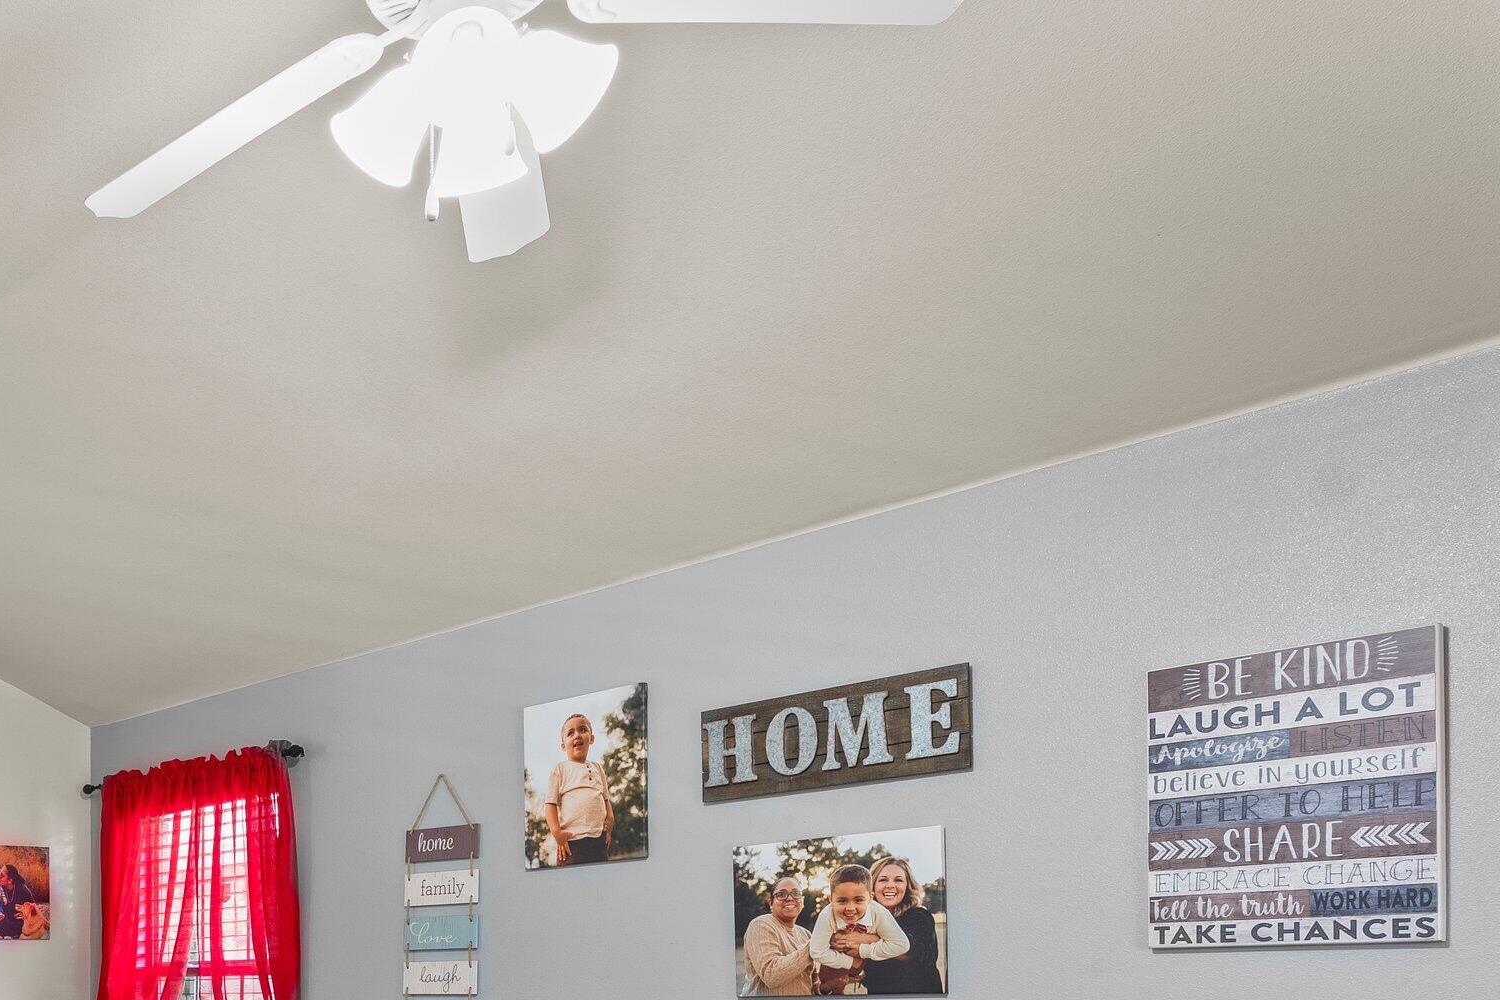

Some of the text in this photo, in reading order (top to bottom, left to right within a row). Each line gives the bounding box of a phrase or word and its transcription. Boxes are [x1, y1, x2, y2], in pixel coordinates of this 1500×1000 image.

[1207, 638, 1370, 700] BE KIND
[1149, 681, 1422, 741] LAUGH A LOT
[702, 677, 961, 788] HOME
[1300, 714, 1427, 752] LISTEN
[1152, 734, 1286, 766] Apologize
[1153, 768, 1246, 795] believe
[1154, 777, 1436, 828] OFFER TO HELP
[417, 832, 455, 853] home
[1222, 820, 1344, 864] SHARE
[420, 877, 465, 900] family
[1154, 857, 1436, 894] EMBRACE CHANGE
[1150, 892, 1305, 922] Tell the truth
[1312, 887, 1433, 912] WORK HARD
[1153, 917, 1436, 945] TAKE CHANCES
[419, 965, 462, 993] laugh
